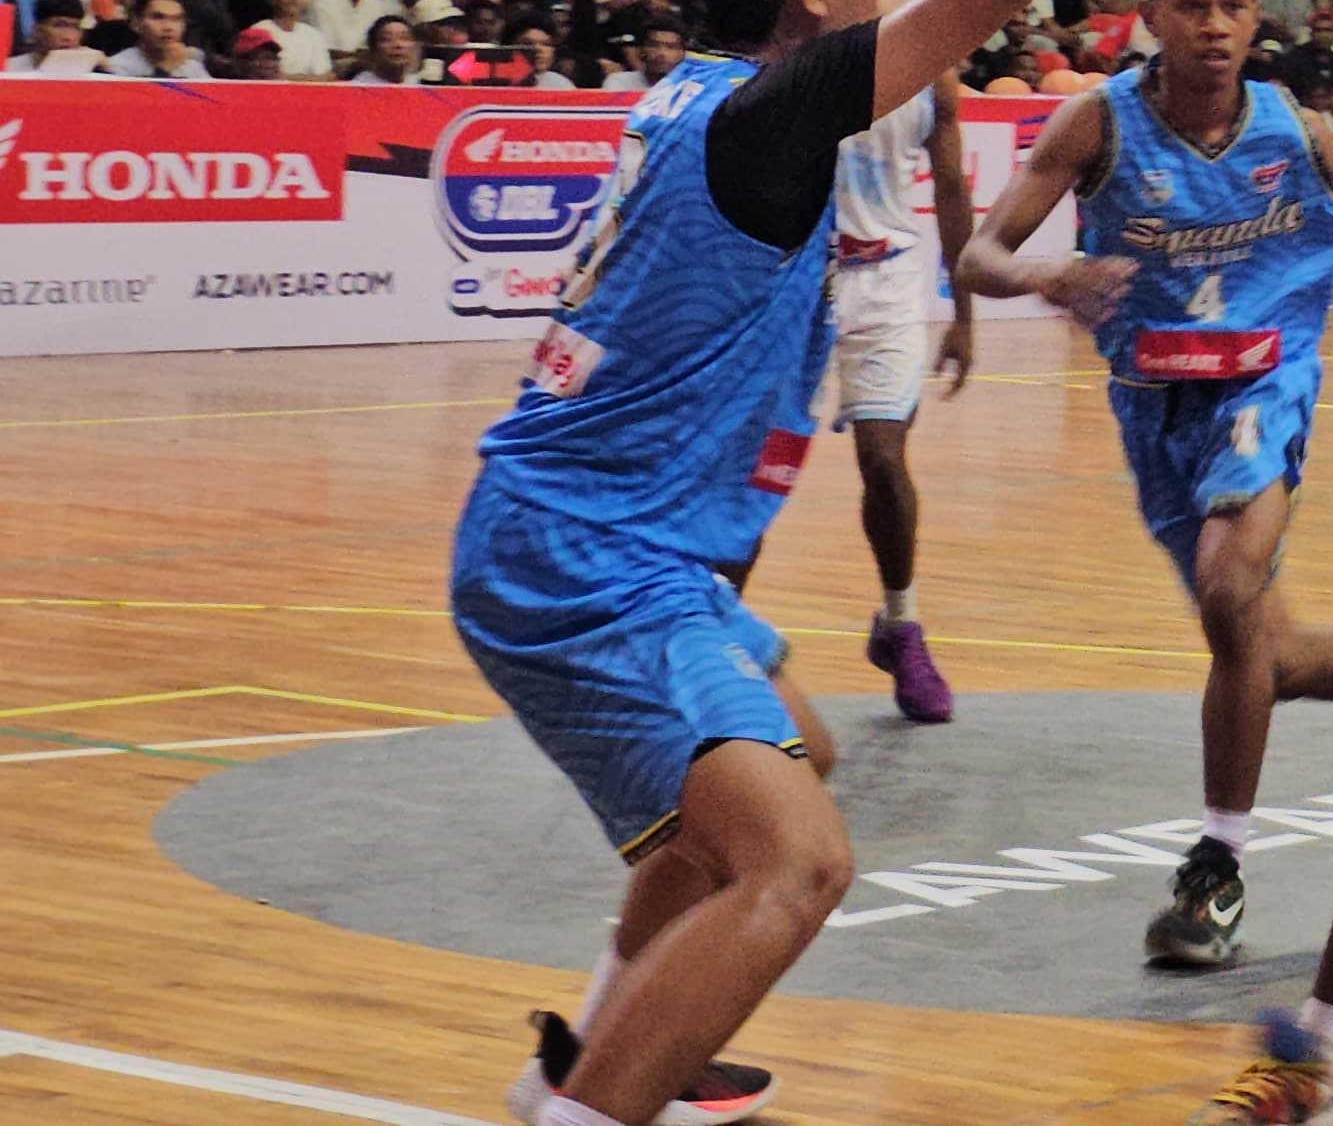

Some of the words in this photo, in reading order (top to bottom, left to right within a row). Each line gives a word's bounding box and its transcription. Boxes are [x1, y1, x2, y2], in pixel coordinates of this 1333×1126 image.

[500, 140, 617, 163] HONDA
[19, 150, 331, 201] HONDA
[191, 271, 397, 300] AZAWEAR.COM
[1184, 272, 1227, 322] 4
